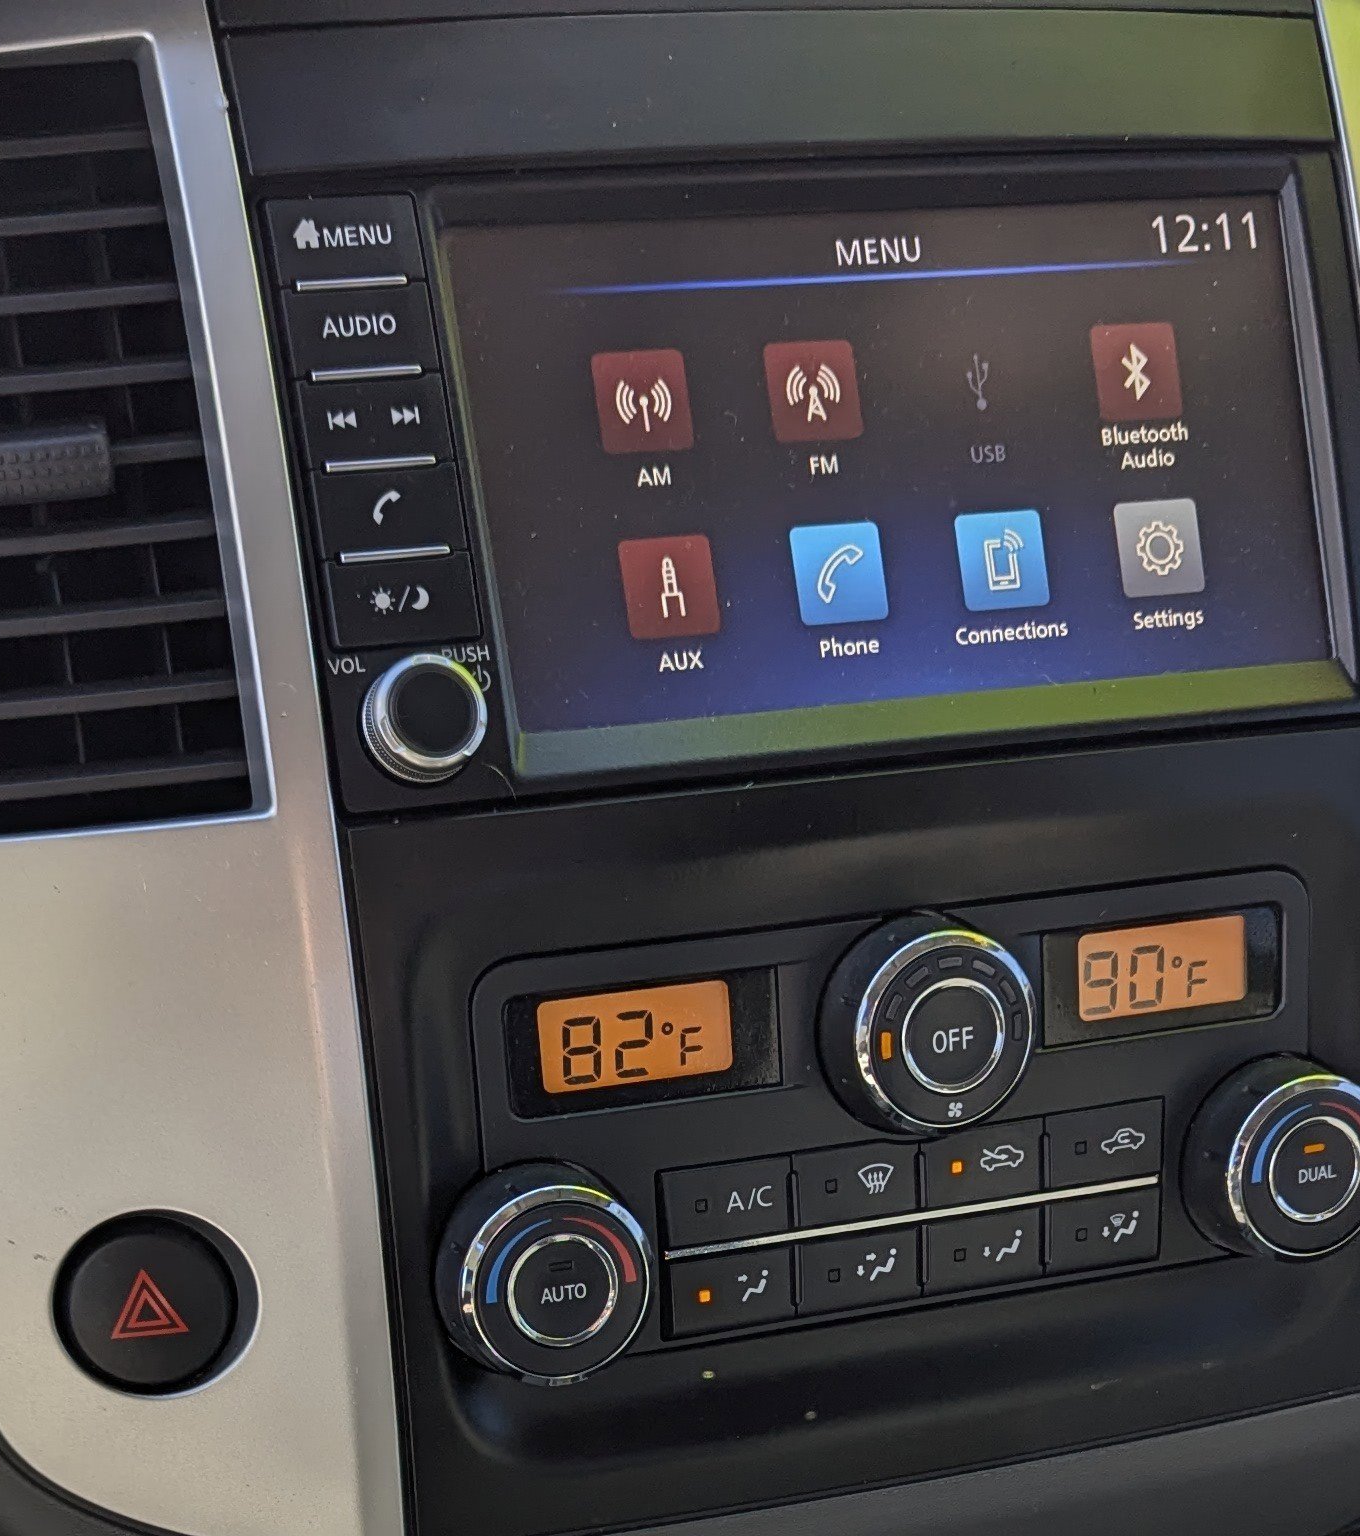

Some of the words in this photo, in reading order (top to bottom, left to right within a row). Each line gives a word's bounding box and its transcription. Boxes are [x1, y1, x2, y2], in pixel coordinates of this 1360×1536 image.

[322, 224, 393, 248] MENU
[1149, 210, 1260, 254] 12:11
[834, 236, 922, 267] MENU
[322, 314, 397, 339] AUDIO
[1100, 422, 1189, 447] Bluetooth
[808, 455, 840, 476] FM
[970, 444, 1006, 465] USB
[1120, 447, 1175, 469] Audio
[636, 466, 672, 488] AM
[1132, 606, 1205, 632] Settings
[954, 618, 1069, 647] Connections
[818, 635, 881, 660] Phone
[328, 655, 366, 675] VOL
[658, 649, 705, 673] AUX
[931, 1026, 975, 1054] OFF
[1297, 1166, 1337, 1185] DUAL
[726, 1184, 774, 1214] A/C
[540, 1282, 588, 1305] AUTO
